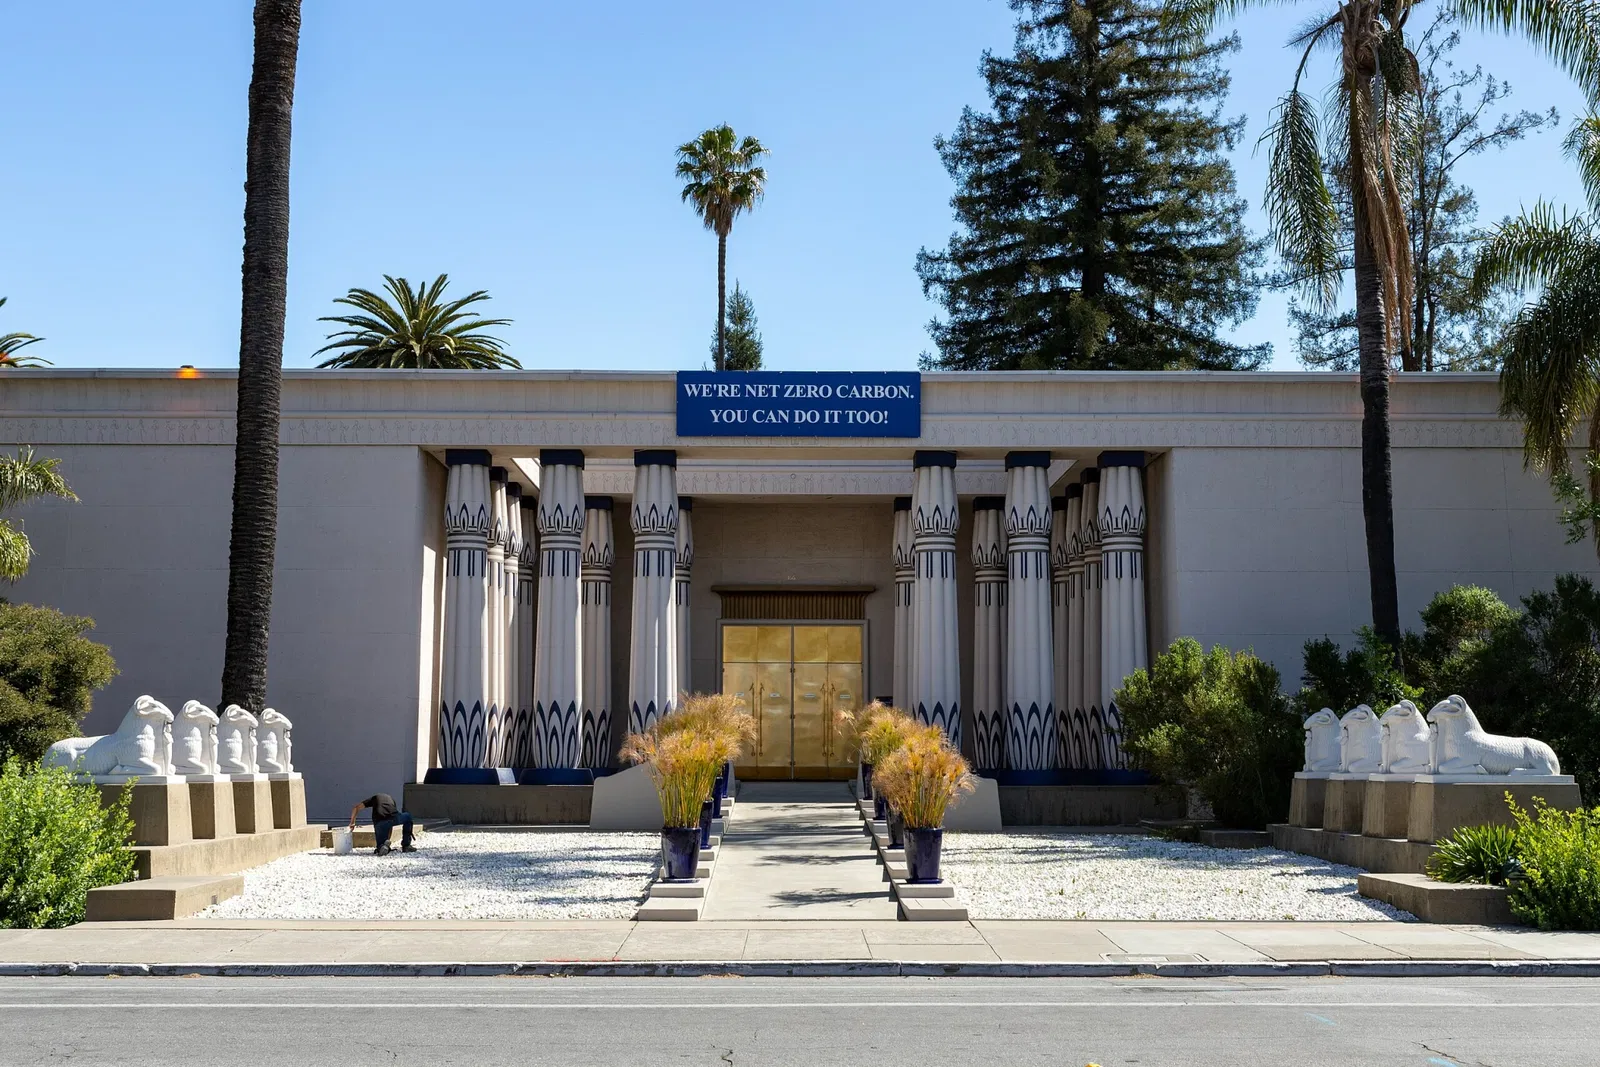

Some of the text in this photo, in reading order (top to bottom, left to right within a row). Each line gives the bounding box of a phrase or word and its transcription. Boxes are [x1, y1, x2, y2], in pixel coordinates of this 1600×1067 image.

[683, 384, 915, 398] WE'RE NET ZERO CARBON.
[709, 409, 888, 424] YOU CAN DO IT TOO!
